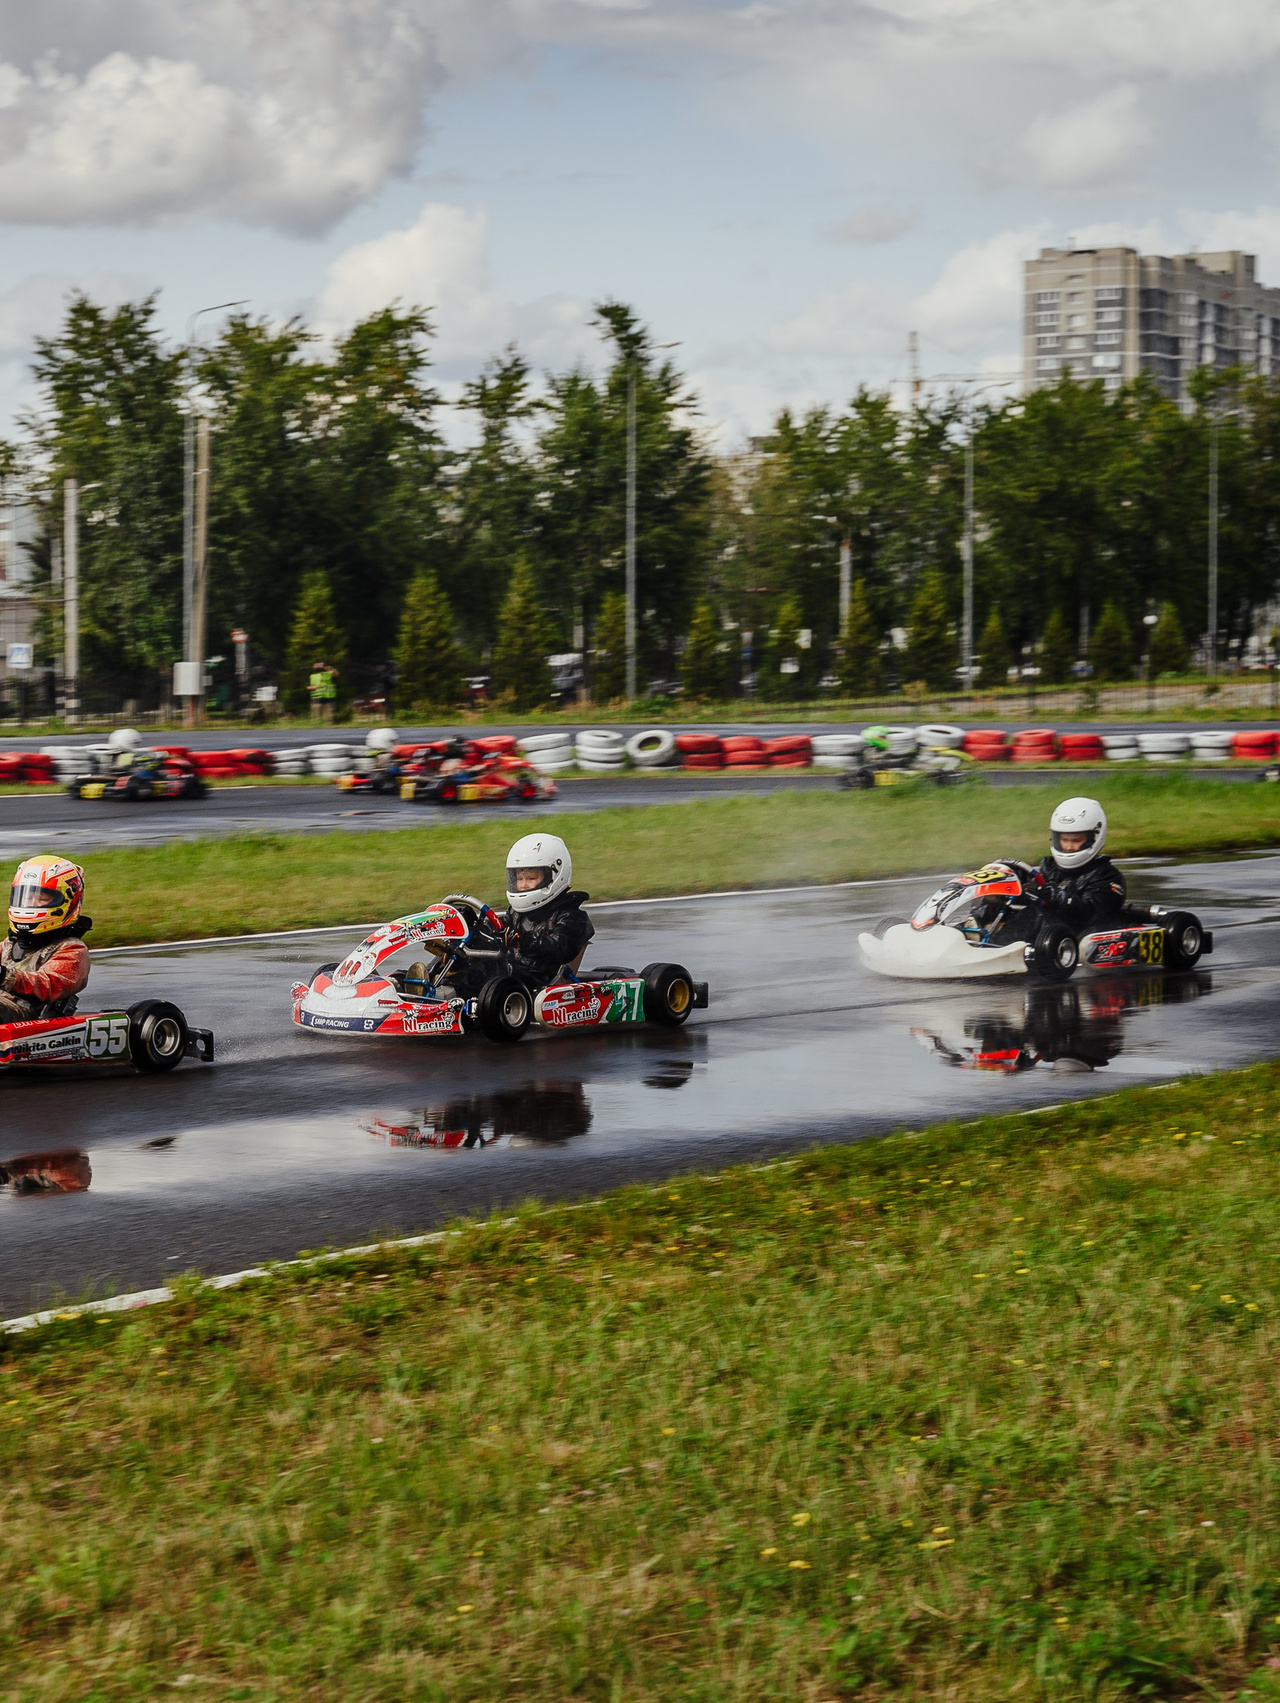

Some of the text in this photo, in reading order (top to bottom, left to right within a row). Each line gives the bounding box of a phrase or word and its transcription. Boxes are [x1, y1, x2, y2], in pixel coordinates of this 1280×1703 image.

[1141, 931, 1162, 962] 38
[617, 982, 641, 1021] 17
[89, 1018, 128, 1056] 55
[325, 1019, 350, 1028] RACING
[14, 1035, 82, 1054] Nikita Galkin
